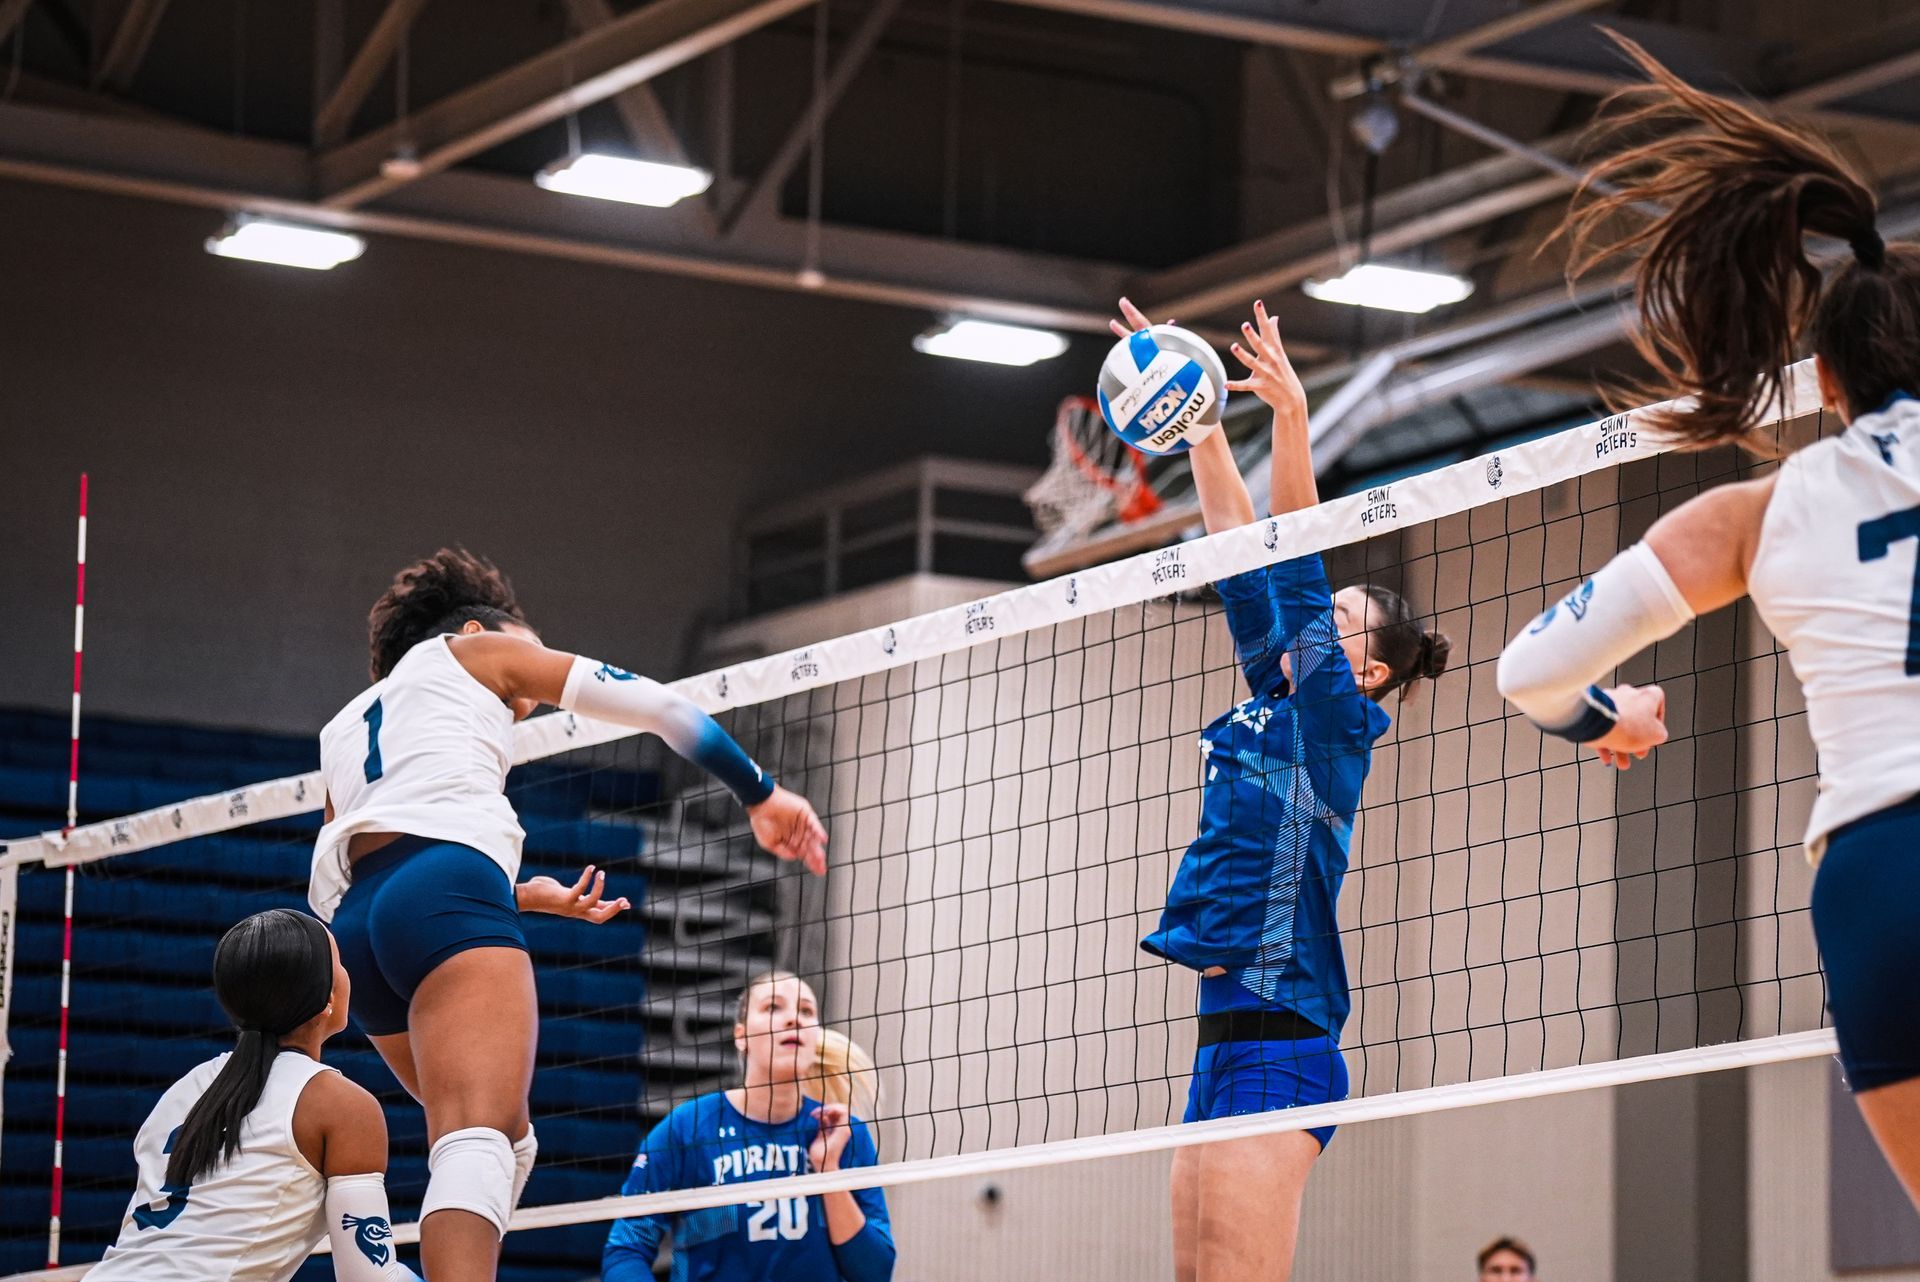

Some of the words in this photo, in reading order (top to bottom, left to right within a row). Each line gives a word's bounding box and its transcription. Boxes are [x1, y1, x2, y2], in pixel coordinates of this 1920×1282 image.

[1138, 381, 1188, 433] NCAA
[1152, 392, 1205, 446] molten
[1600, 413, 1630, 437] SAINT
[1596, 432, 1637, 458] PETER'S
[1367, 486, 1391, 506] SAINT
[1361, 503, 1397, 527] PETER'S
[1156, 547, 1180, 567] SAINT
[1152, 563, 1186, 585] PETER'S
[363, 694, 383, 784] 1
[711, 1143, 812, 1186] PIRAT
[746, 1196, 809, 1242] 20
